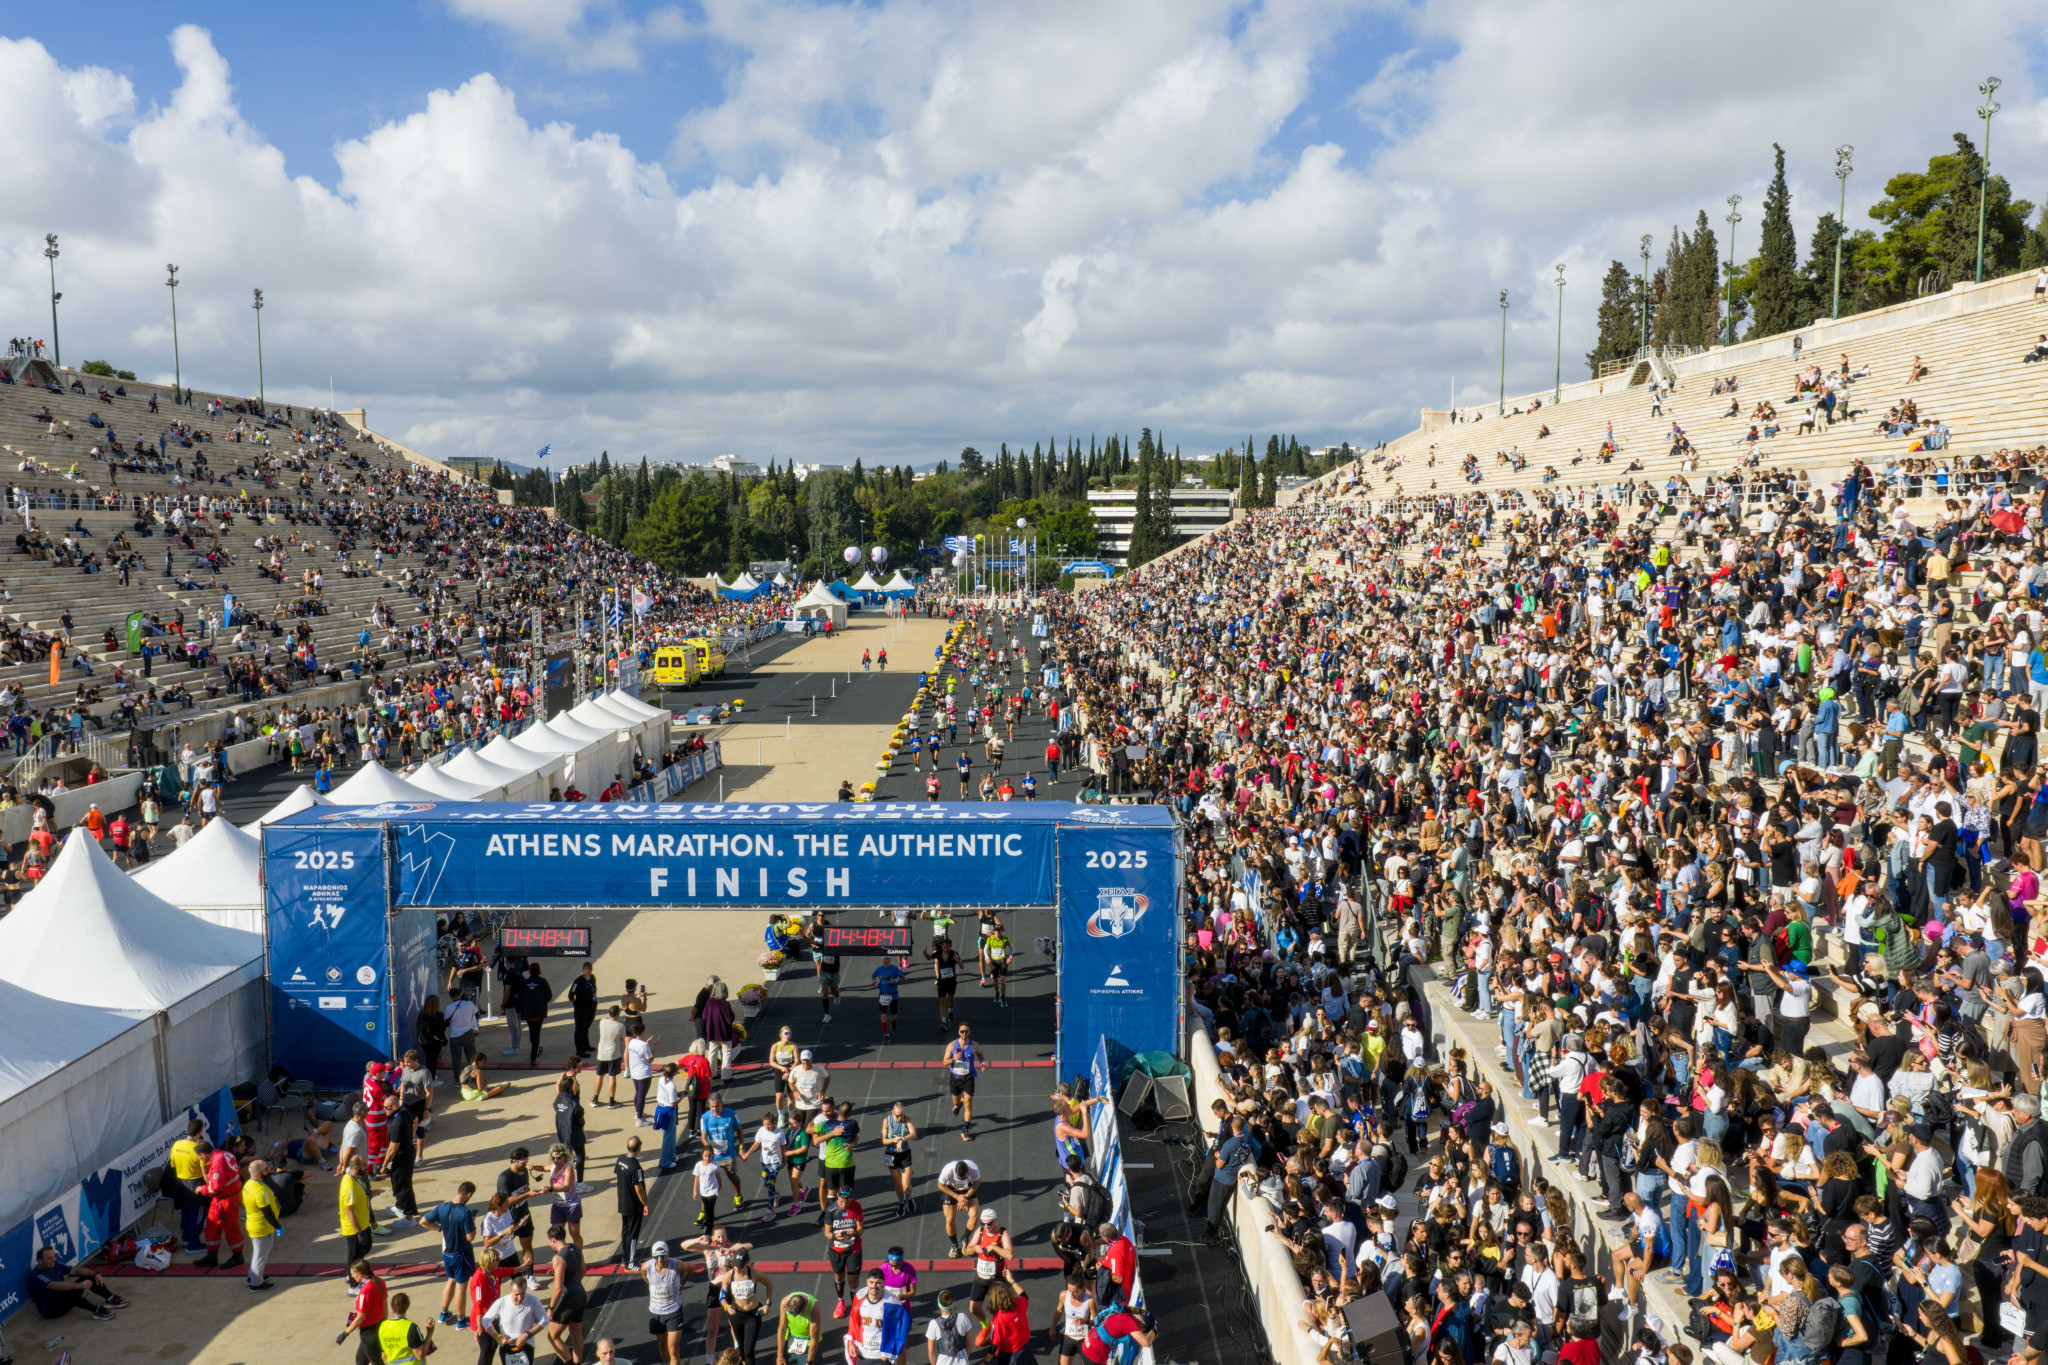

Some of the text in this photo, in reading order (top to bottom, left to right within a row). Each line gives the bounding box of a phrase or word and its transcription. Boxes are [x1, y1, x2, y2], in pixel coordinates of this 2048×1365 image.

[131, 619, 139, 632] 9
[522, 804, 948, 813] THE AUTHENTIC
[797, 812, 1012, 820] ATHENS
[485, 834, 1023, 857] ATHENS MARATHON. THE AUTHENTIC
[294, 851, 354, 869] 2025
[1085, 851, 1148, 869] 2025
[650, 867, 850, 897] FINISH
[1098, 888, 1135, 896] ΣΕΓΑΣ
[505, 929, 585, 947] 04:48:47
[828, 928, 907, 946] 04:48:47
[123, 1151, 156, 1179] Marathon
[156, 1146, 164, 1156] to
[128, 1178, 145, 1194] The
